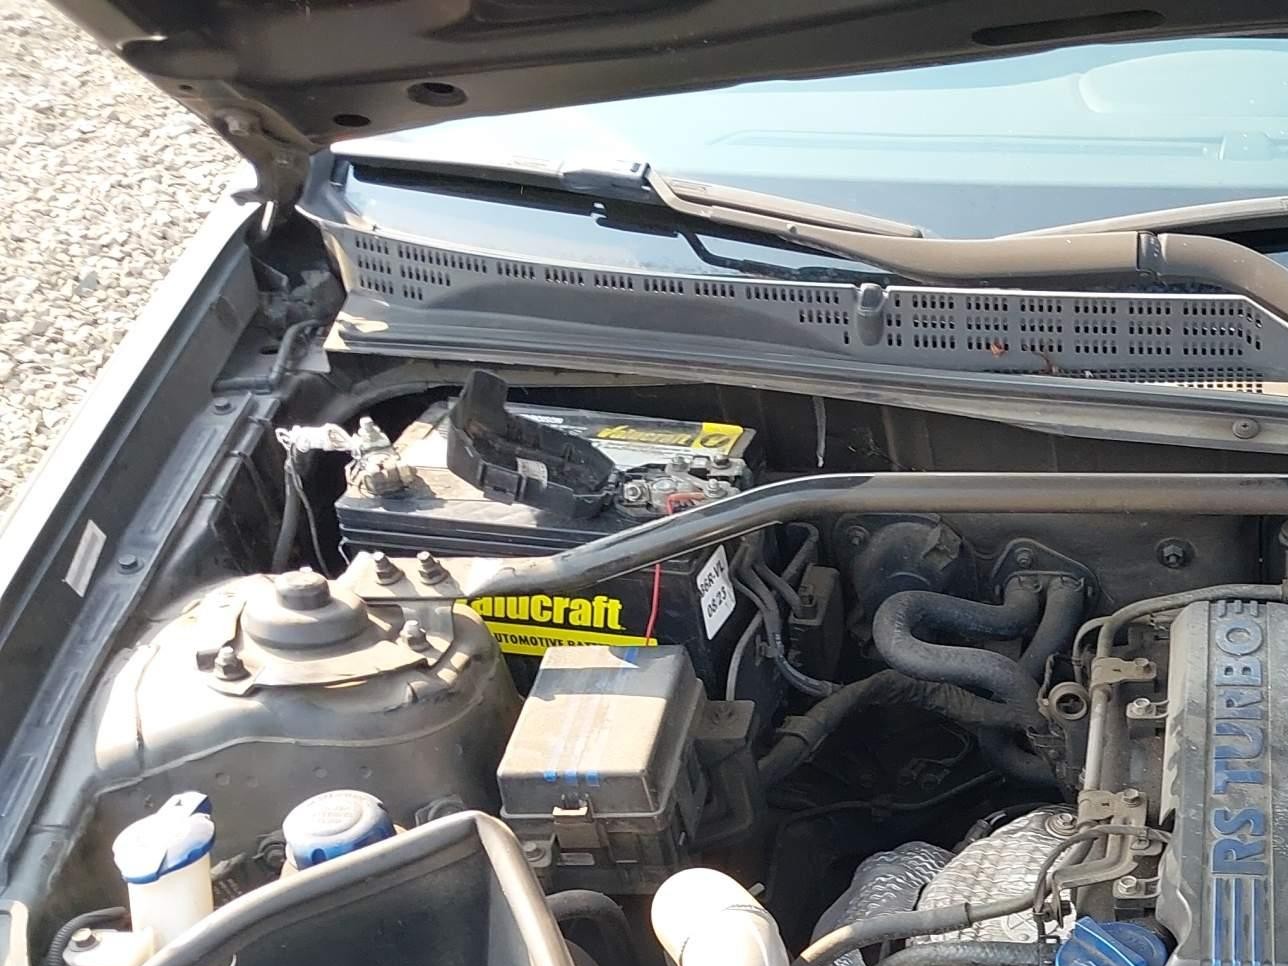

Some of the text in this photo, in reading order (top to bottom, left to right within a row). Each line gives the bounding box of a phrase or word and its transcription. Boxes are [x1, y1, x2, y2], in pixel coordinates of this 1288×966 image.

[493, 632, 564, 647] UTOMOTIVE
[1210, 618, 1266, 875] RS TURBO
